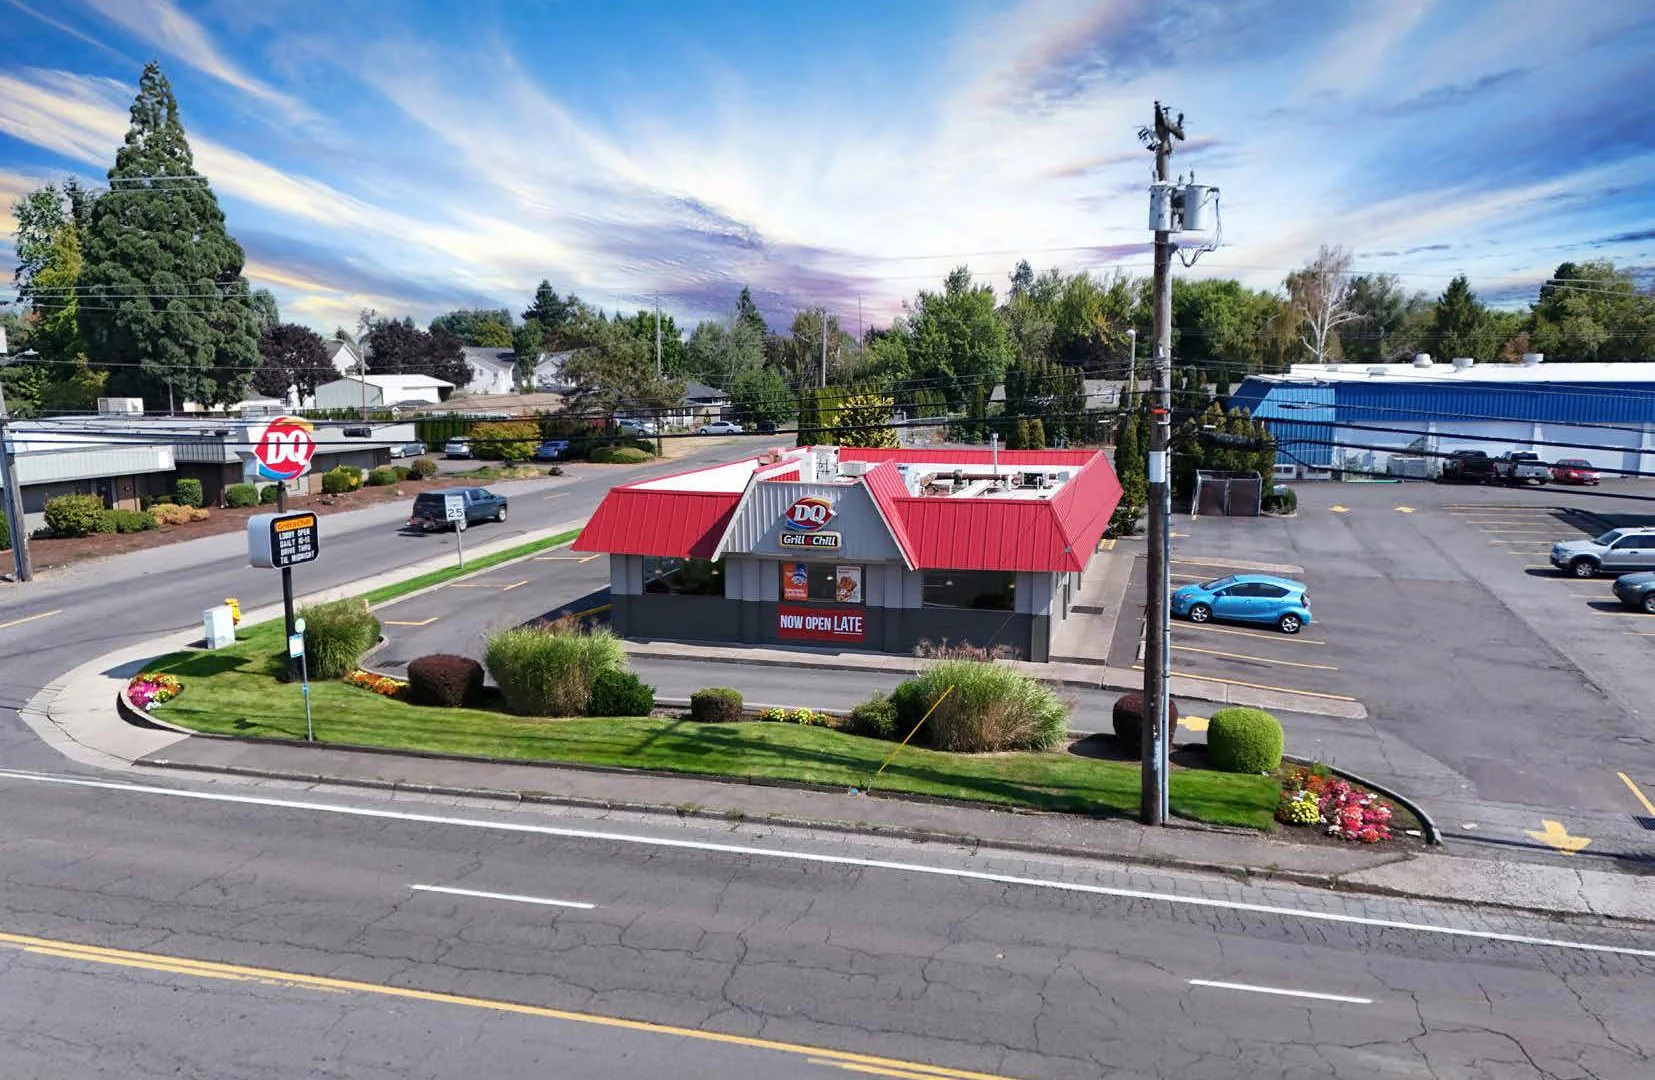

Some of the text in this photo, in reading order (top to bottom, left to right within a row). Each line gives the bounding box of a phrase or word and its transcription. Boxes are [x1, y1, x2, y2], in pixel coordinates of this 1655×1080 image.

[266, 430, 308, 465] DQ
[447, 508, 463, 518] 25
[793, 504, 826, 524] DQ
[280, 547, 296, 556] DRIVE
[780, 615, 862, 632] NOW OPEN LATE
